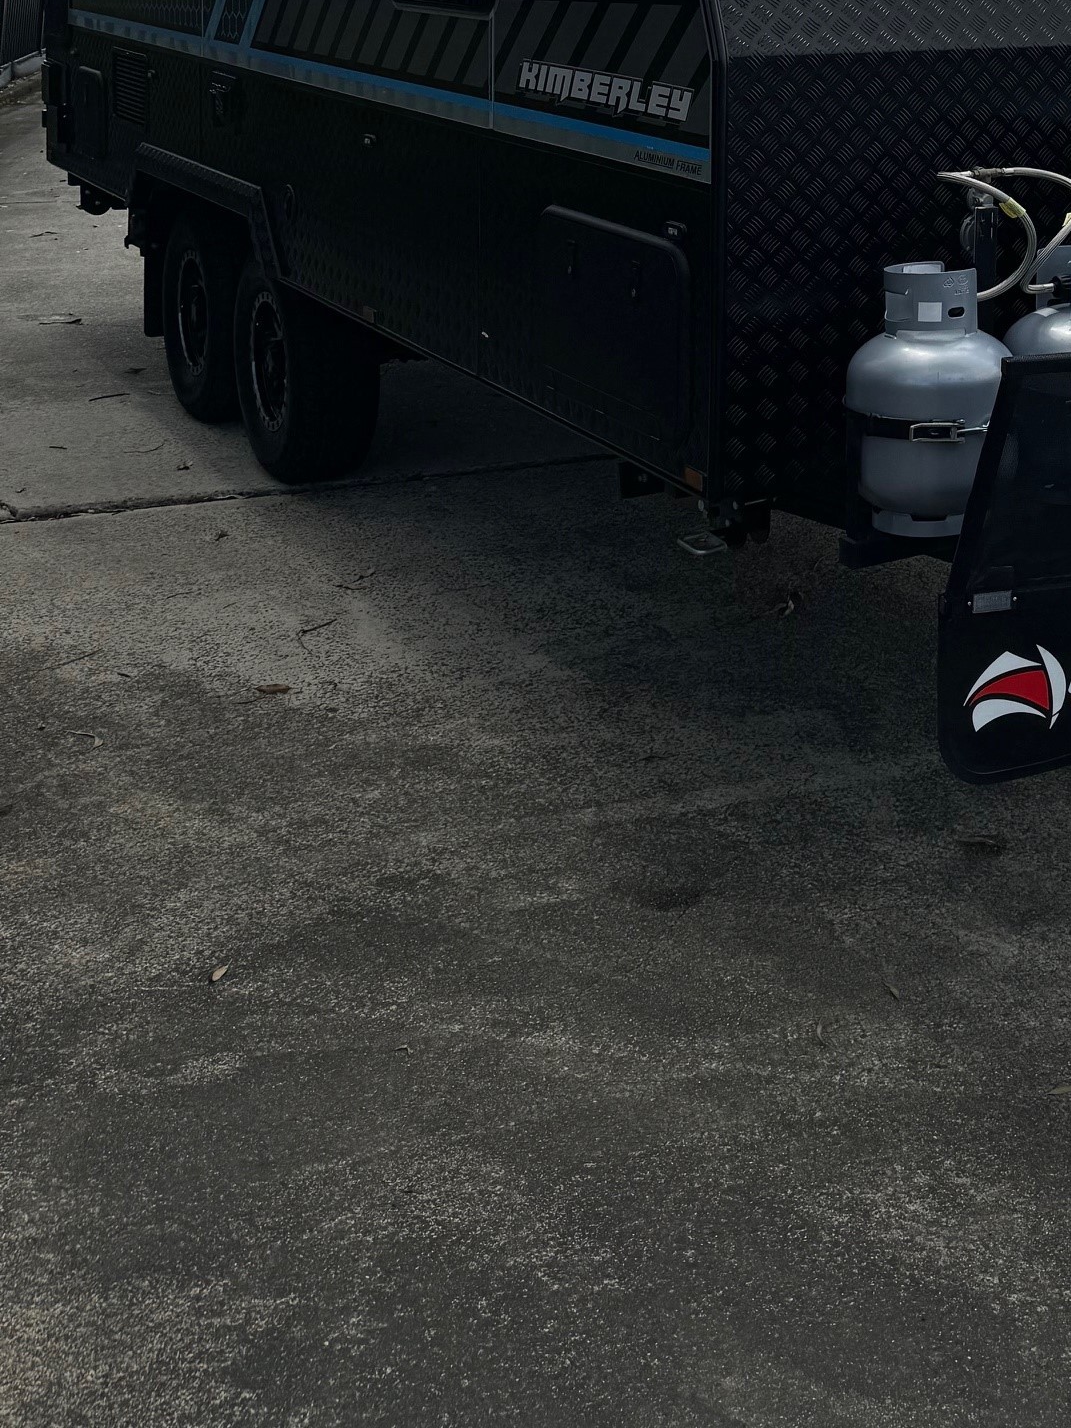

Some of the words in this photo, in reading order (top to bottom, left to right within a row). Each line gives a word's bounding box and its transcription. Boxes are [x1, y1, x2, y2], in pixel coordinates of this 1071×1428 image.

[518, 59, 693, 122] KIMBERLEY
[634, 150, 675, 168] ALUMINIUM
[676, 160, 702, 175] FRAME
